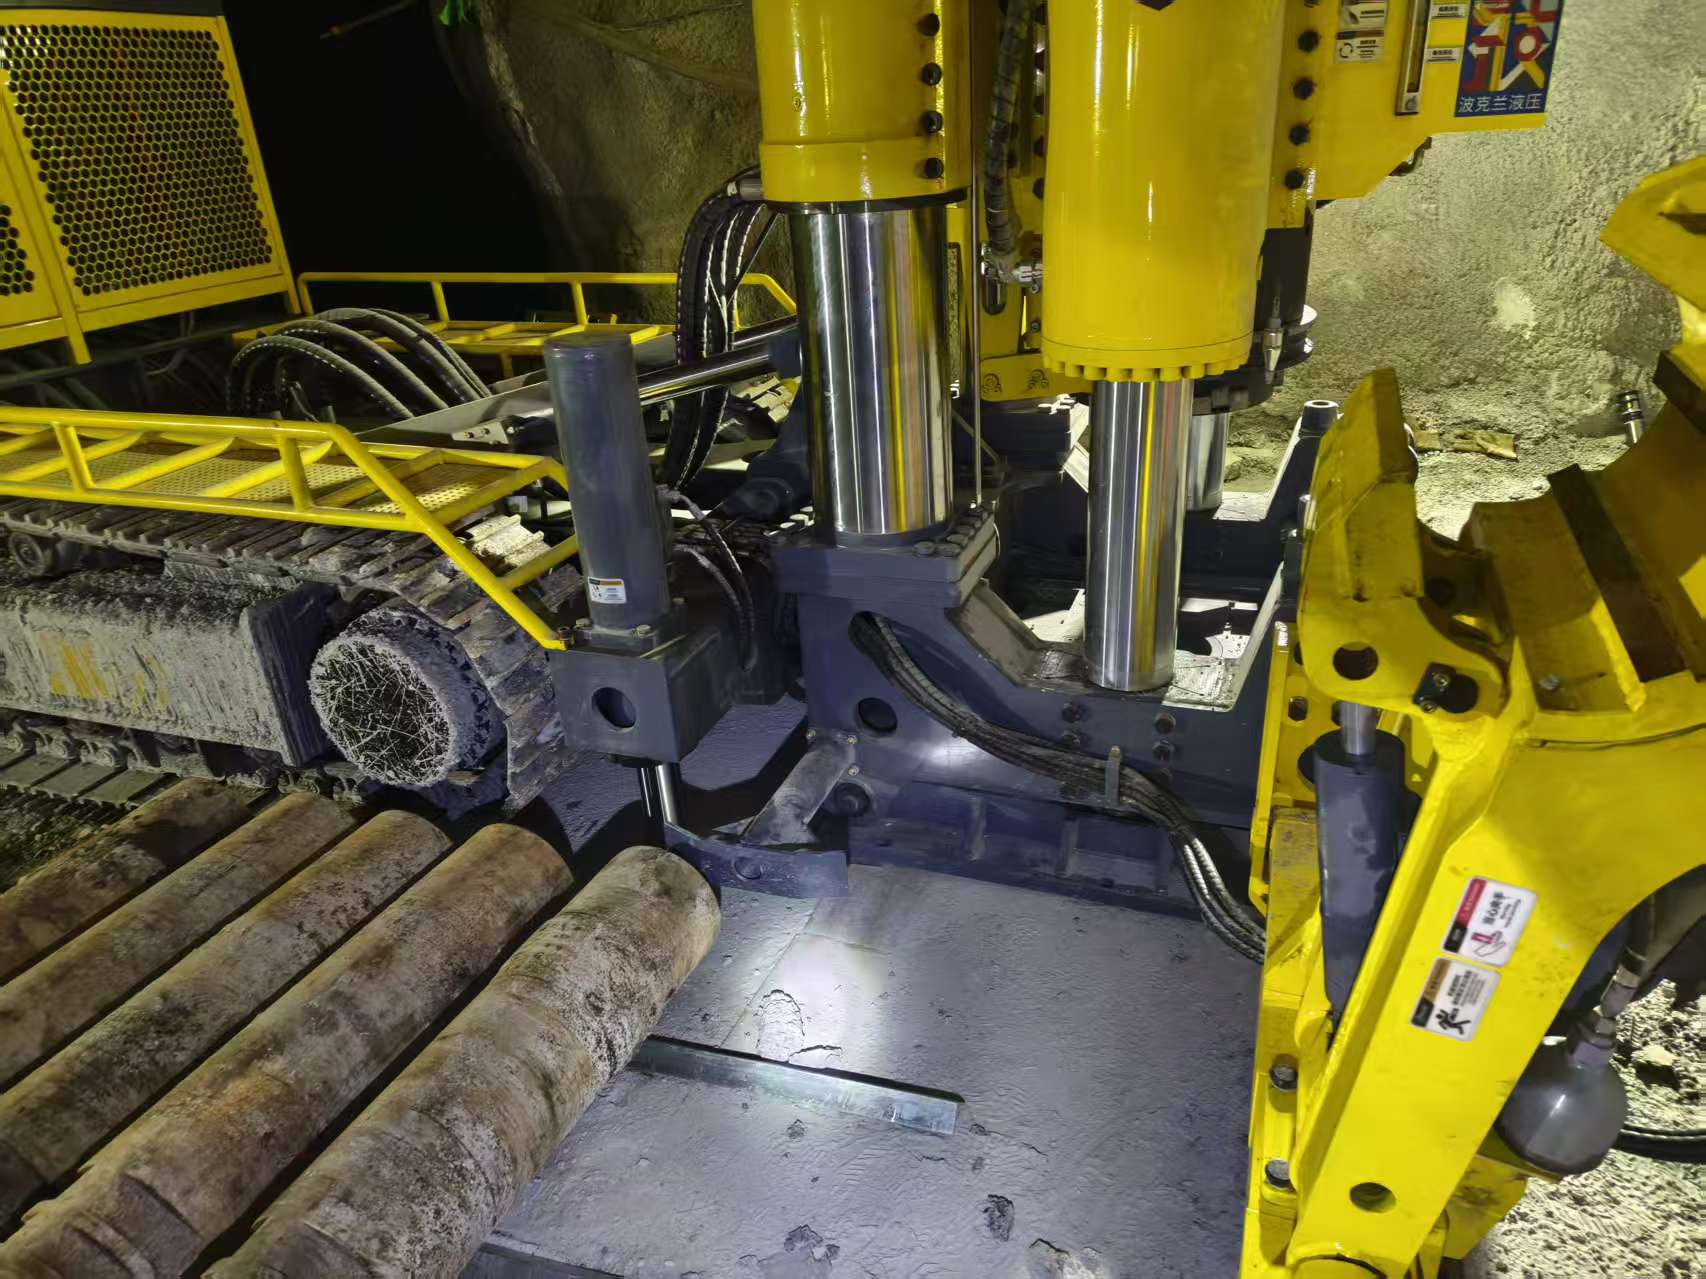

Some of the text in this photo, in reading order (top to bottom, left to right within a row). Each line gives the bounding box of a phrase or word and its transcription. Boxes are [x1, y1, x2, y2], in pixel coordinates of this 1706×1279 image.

[1458, 93, 1543, 113] 波克兰液压
